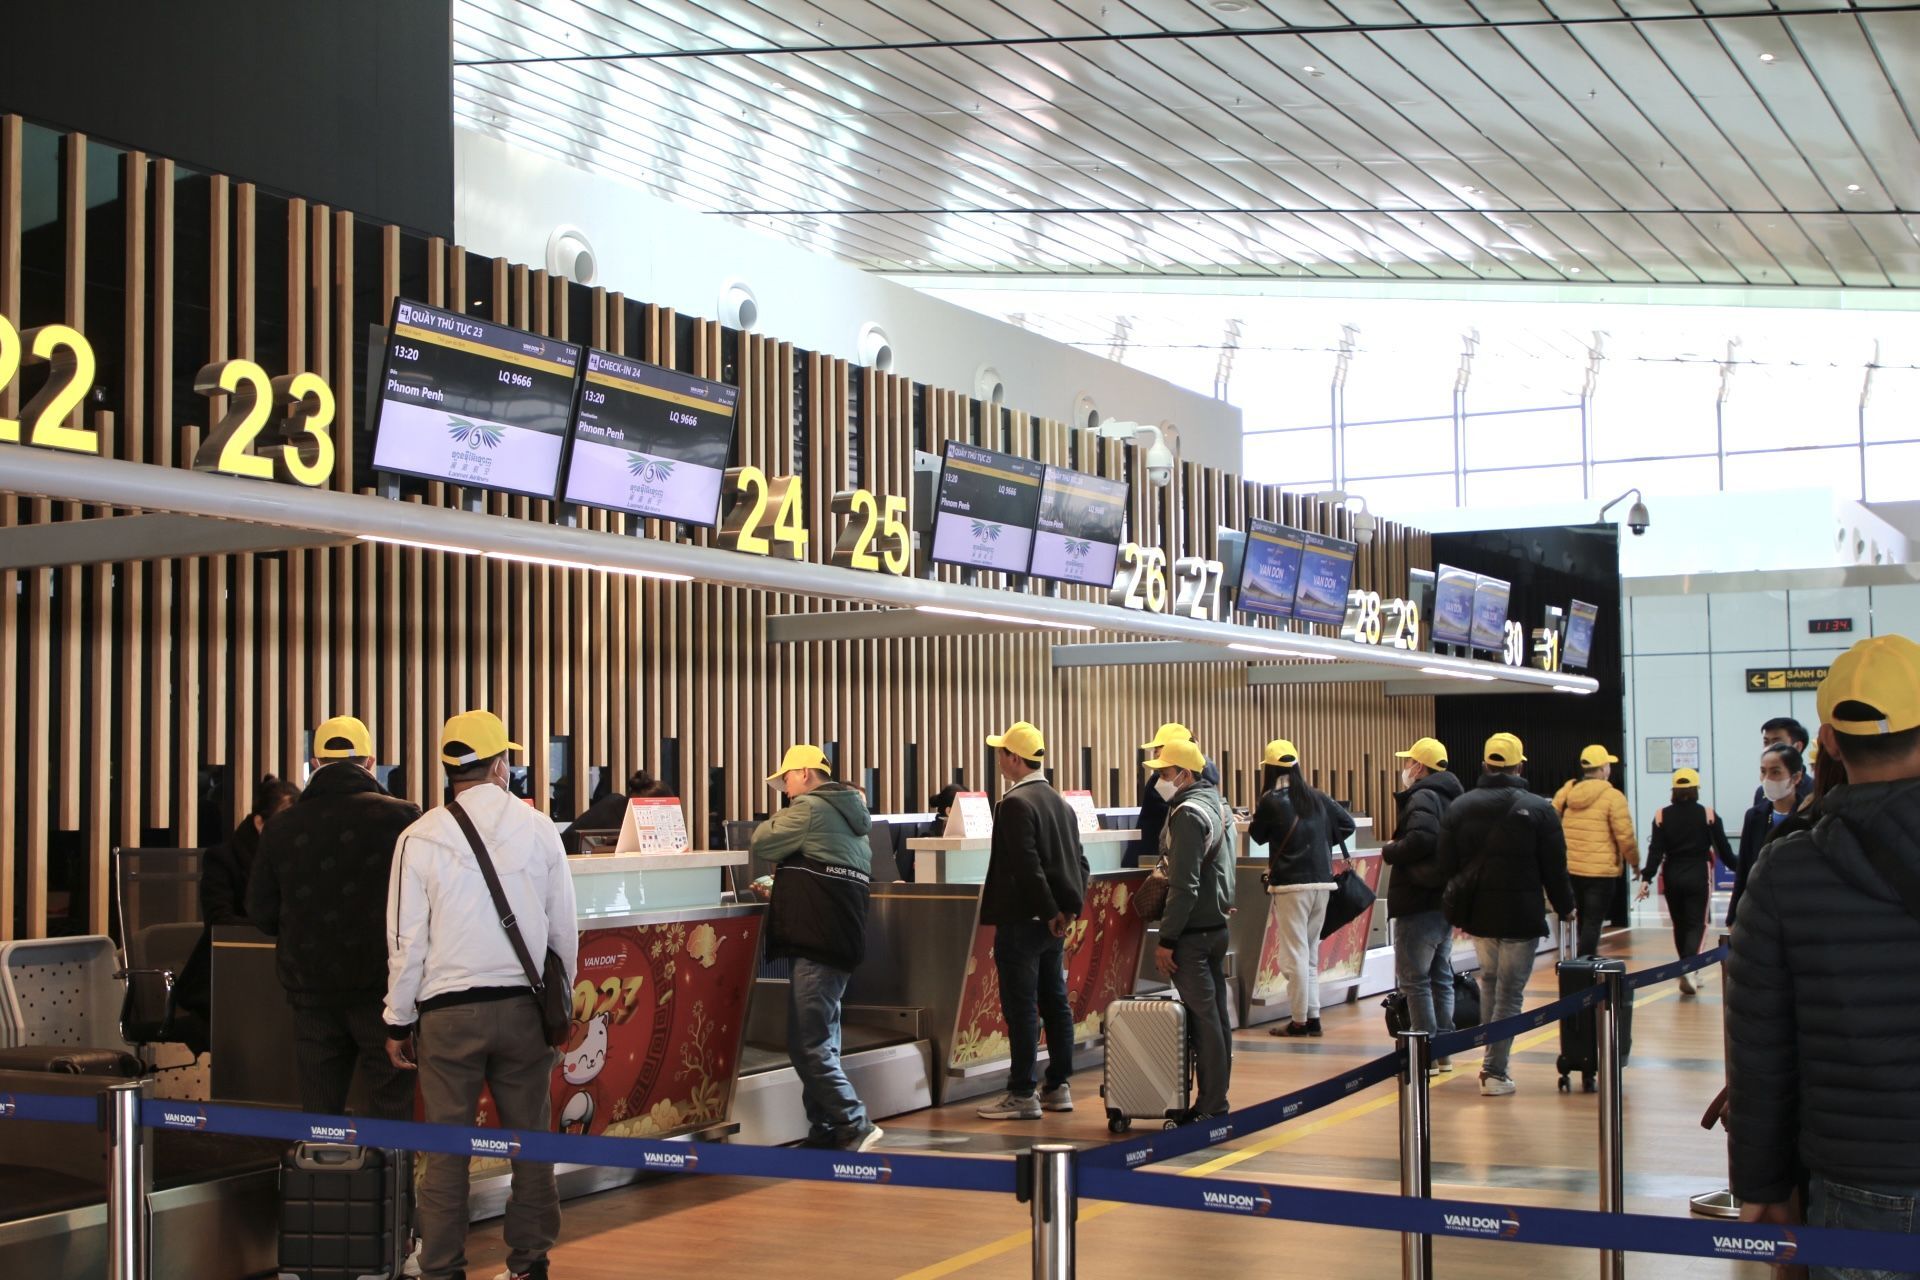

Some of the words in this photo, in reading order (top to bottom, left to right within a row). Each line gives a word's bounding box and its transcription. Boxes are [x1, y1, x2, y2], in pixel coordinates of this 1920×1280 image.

[437, 317, 454, 330] THỦ
[456, 321, 472, 336] TỤC
[472, 326, 483, 338] 23
[394, 344, 419, 361] 13:20
[600, 360, 632, 376] CHECK-IN
[632, 368, 641, 378] 24
[499, 370, 510, 384] LQ
[511, 374, 532, 388] 9666
[388, 379, 420, 397] Phnom
[422, 386, 444, 402] Penh
[585, 390, 605, 404] 13:20
[219, 359, 335, 487] 23
[670, 410, 680, 424] LQ
[680, 414, 698, 426] 9666
[578, 420, 605, 436] Phnom
[606, 426, 625, 441] Penh
[940, 498, 958, 508] Phnom
[958, 500, 970, 510] Penh
[737, 466, 809, 560] 24
[851, 489, 910, 574] 25
[1125, 543, 1166, 613] 26
[1271, 566, 1284, 579] DON
[1190, 557, 1223, 621] 27
[1324, 578, 1336, 590] DON
[1354, 589, 1380, 645] 28
[1393, 598, 1418, 651] 29
[1504, 620, 1524, 667] 30
[1542, 628, 1558, 672] 31
[584, 957, 600, 967] VAN
[600, 954, 616, 966] DON
[164, 1112, 180, 1122] VAN
[180, 1114, 196, 1124] DON
[311, 1126, 328, 1135] VAN
[328, 1128, 345, 1136] DON
[472, 1138, 489, 1148] VAN
[490, 1140, 508, 1150] DON
[644, 1152, 664, 1162] VAN
[664, 1154, 684, 1164] DON
[1126, 1152, 1136, 1162] VAN
[1136, 1150, 1146, 1160] DON
[832, 1164, 854, 1174] VAN
[855, 1165, 877, 1176] DON
[1203, 1192, 1228, 1204] VAN
[1228, 1194, 1254, 1207] DON
[1444, 1214, 1470, 1227] VAN
[1472, 1216, 1500, 1230] DON
[1712, 1236, 1742, 1249] VAN
[1744, 1238, 1775, 1252] DON
